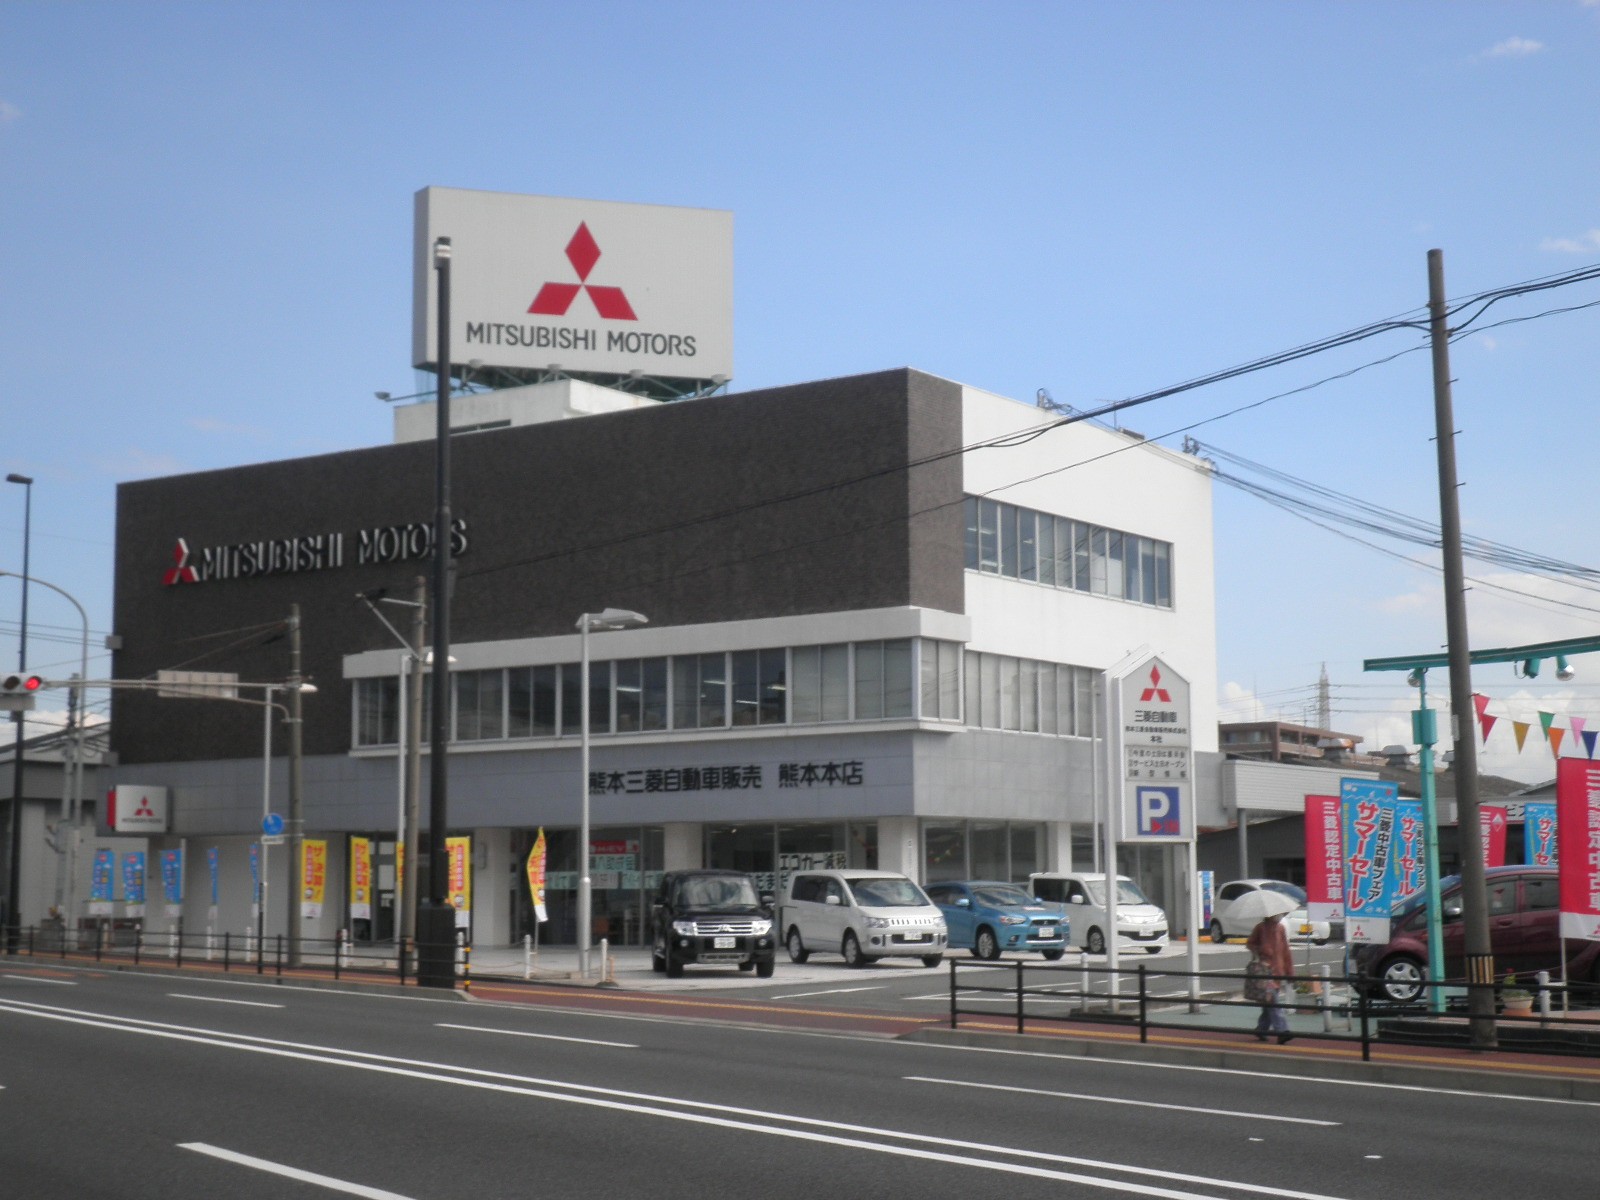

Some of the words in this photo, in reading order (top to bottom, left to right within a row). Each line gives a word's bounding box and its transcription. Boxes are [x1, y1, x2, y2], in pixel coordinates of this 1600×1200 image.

[466, 321, 596, 351] MITSUBISHI
[607, 330, 697, 357] MOTORS
[201, 533, 343, 582] MITSUBISHI
[358, 519, 468, 565] MOTOS
[589, 765, 762, 795] 熊本三菱自動車販売
[778, 760, 864, 788] 熊本本店
[1141, 790, 1170, 832] P
[1347, 801, 1380, 912] サマーセール
[1367, 806, 1394, 903] 三菱中古車フェア
[1398, 817, 1416, 896] サマーセール
